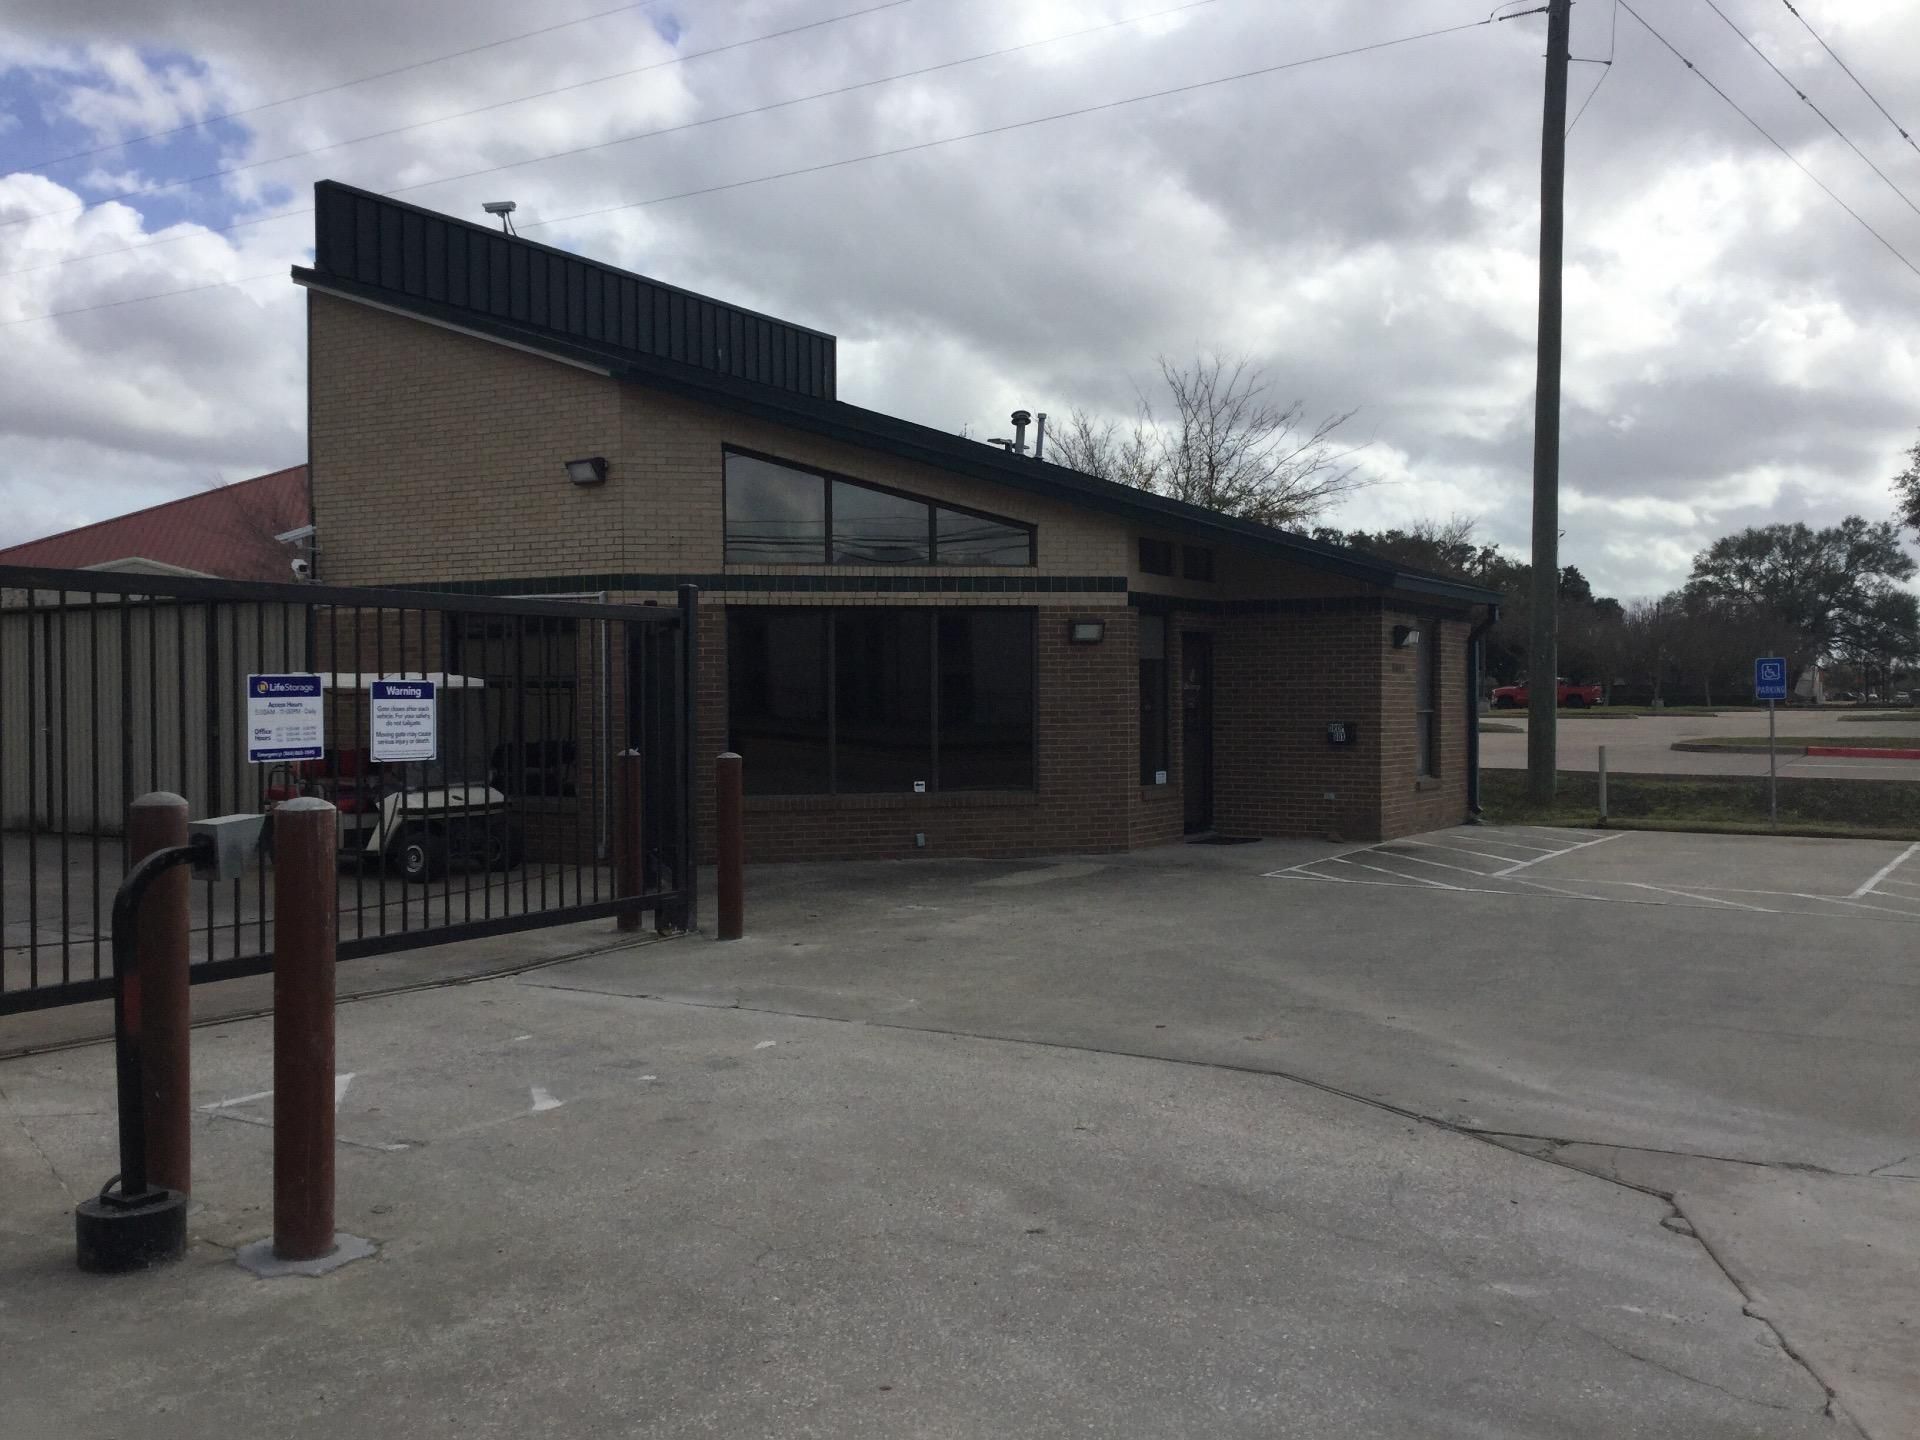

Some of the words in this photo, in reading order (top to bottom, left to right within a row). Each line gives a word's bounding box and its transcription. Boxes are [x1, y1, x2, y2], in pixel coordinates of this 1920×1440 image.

[269, 683, 314, 692] LifeStorage
[386, 686, 421, 697] Warning
[1757, 685, 1785, 694] PARKING
[375, 731, 394, 739] Moving
